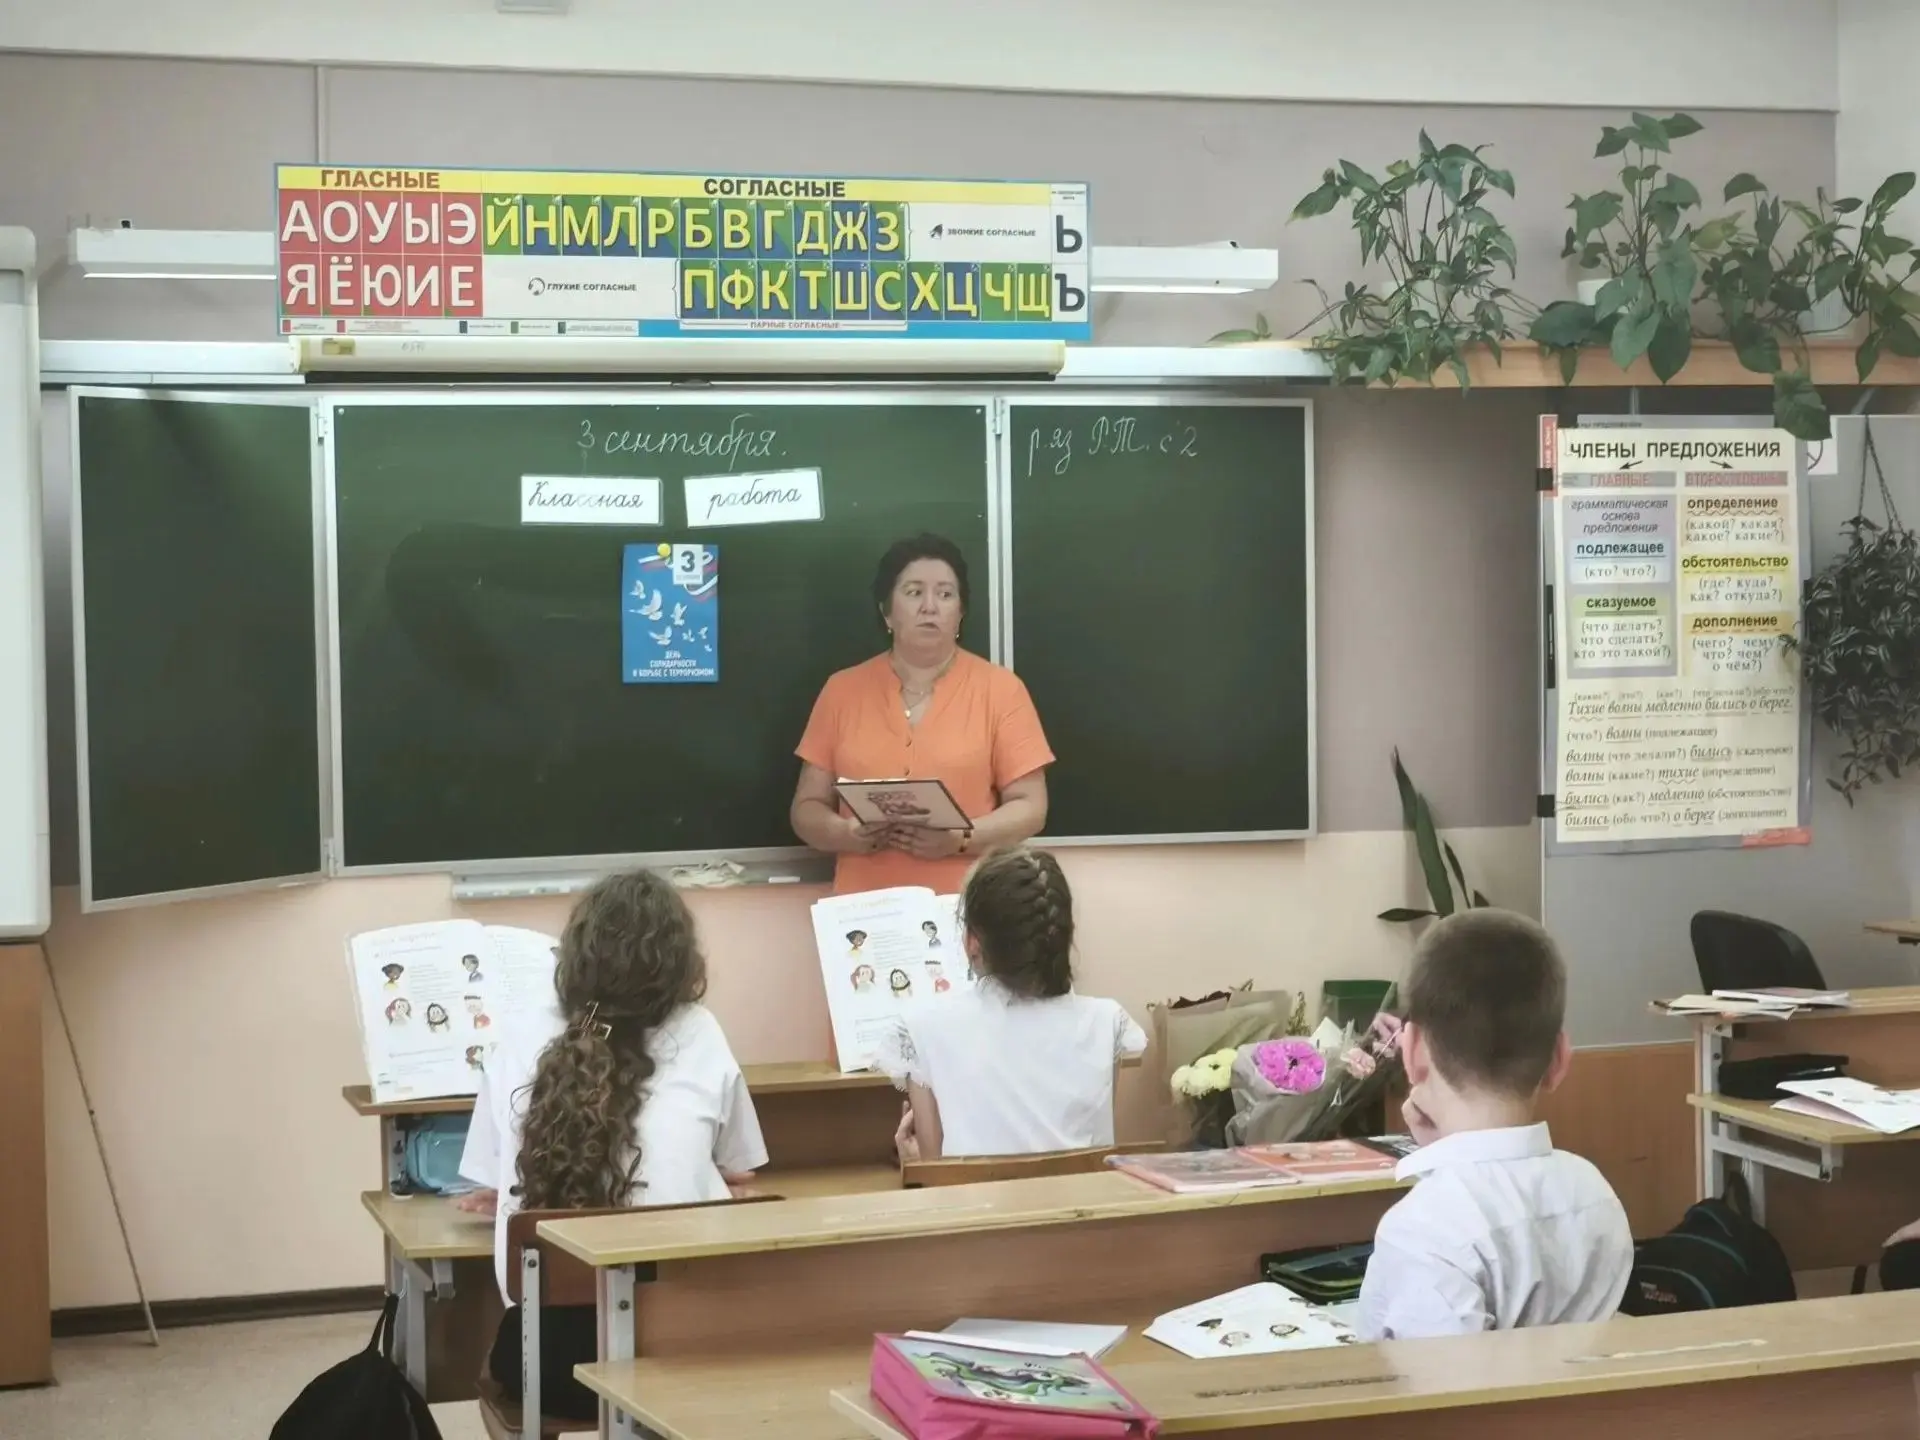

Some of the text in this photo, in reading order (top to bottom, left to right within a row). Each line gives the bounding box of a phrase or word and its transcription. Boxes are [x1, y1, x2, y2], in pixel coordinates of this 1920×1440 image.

[321, 170, 440, 189] ГЛАСНЫЕ
[703, 178, 846, 198] СОГЛАСНЫЕ
[947, 227, 1036, 237] ЗВОНКИЕ СОГЛАСНЫЕ
[547, 282, 637, 292] ГЛУХИЕ СОГЛАСНЫЕ
[576, 419, 595, 448] 3
[1570, 442, 1781, 460] ЧЛЕНЫ ПРЕДЛОЖЕНИЯ
[528, 481, 644, 509] Классная
[707, 478, 802, 519] работа
[1571, 499, 1669, 511] грамматическая
[1687, 497, 1778, 510] определение
[1601, 512, 1641, 521] основа
[1583, 522, 1659, 535] предложения
[1576, 543, 1665, 557] подлежащее
[681, 551, 695, 572] 3
[1682, 555, 1789, 568] обстоятельство
[1586, 596, 1656, 610] сказуемое
[1693, 615, 1778, 629] дополнение
[1580, 634, 1605, 645] что
[1568, 702, 1605, 715] Тихие
[1607, 702, 1642, 713] волны
[1645, 700, 1702, 712] медленно
[1705, 698, 1746, 710] бились
[1605, 727, 1642, 739] волны
[1565, 750, 1605, 763] волны
[1565, 769, 1605, 782] волны
[1658, 767, 1700, 779] тихие
[1564, 792, 1610, 805] бились
[1648, 788, 1705, 801] медленно
[1565, 813, 1610, 826] бились
[1683, 809, 1716, 823] берег
